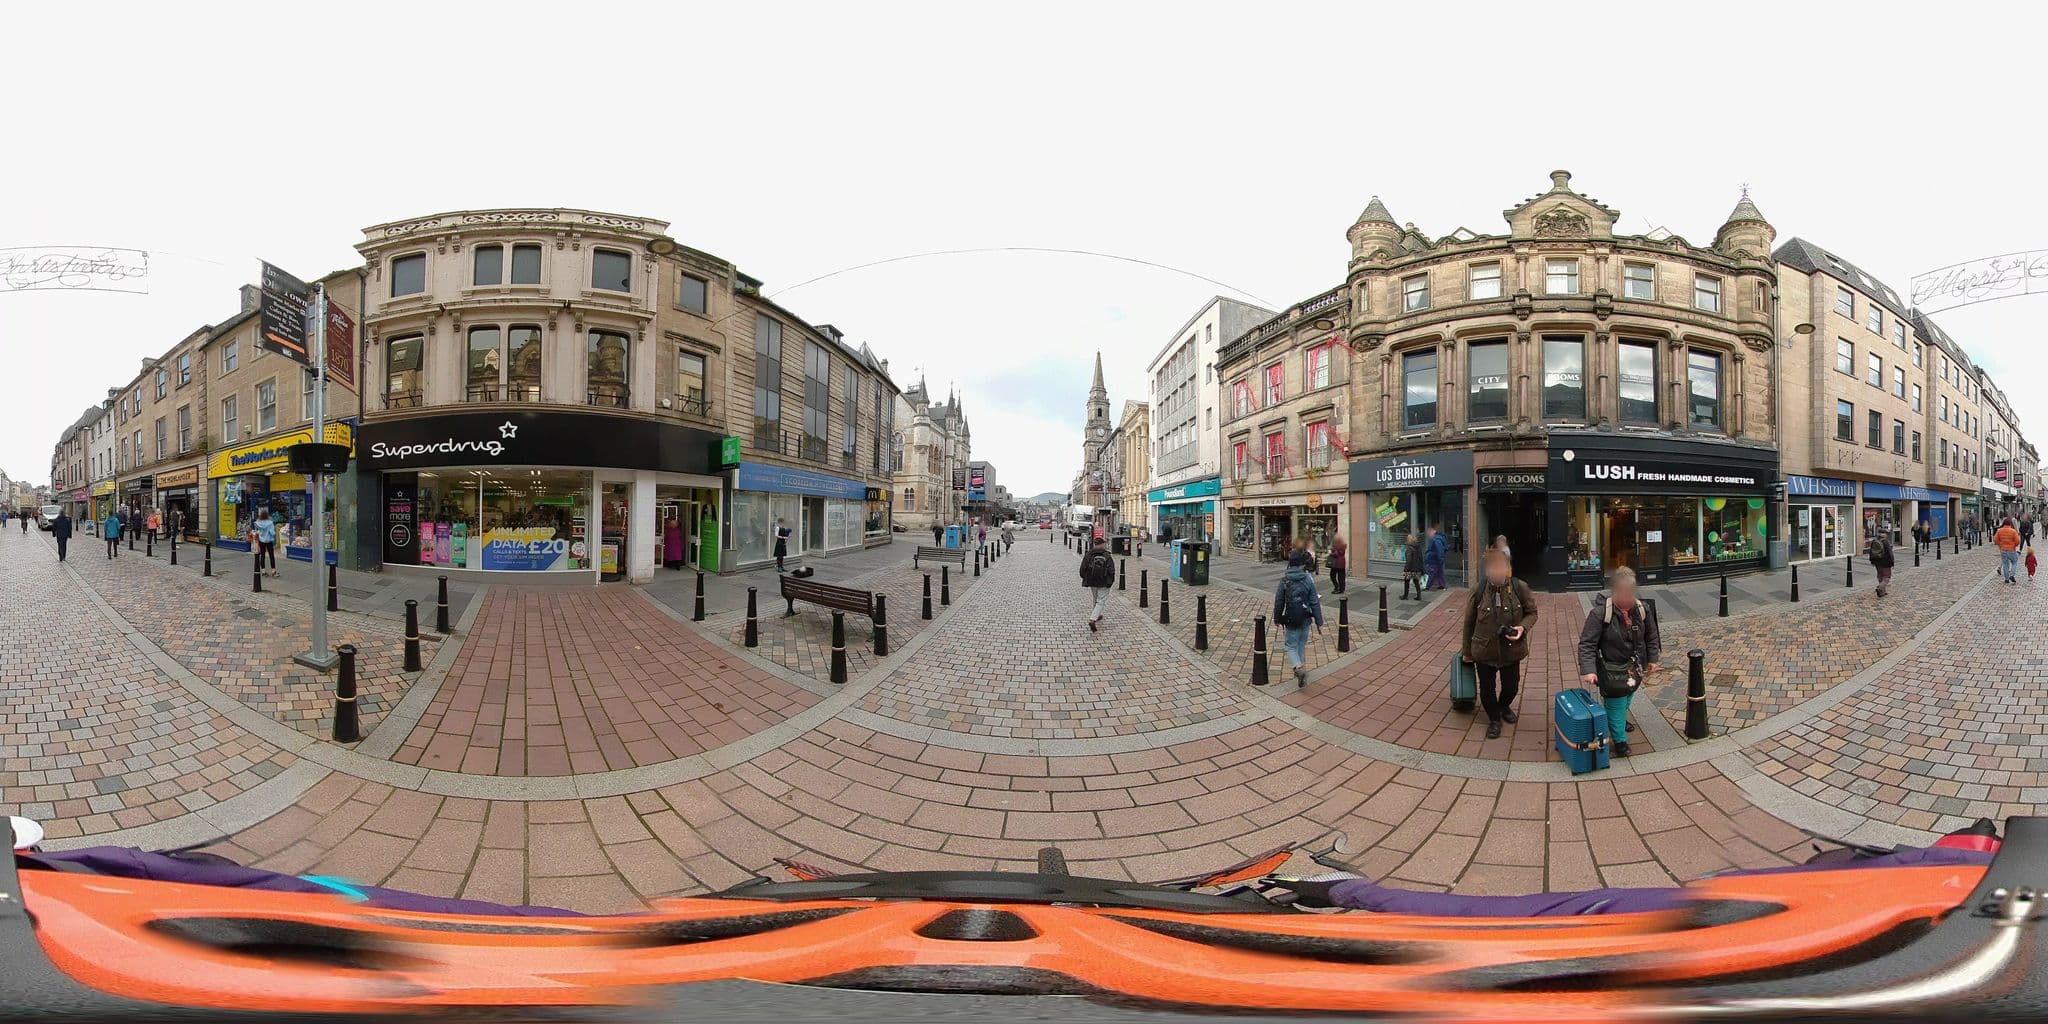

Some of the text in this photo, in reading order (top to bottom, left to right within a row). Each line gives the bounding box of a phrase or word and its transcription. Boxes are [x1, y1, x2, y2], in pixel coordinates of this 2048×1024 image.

[1477, 376, 1501, 384] CITY
[371, 438, 505, 459] Superdrug
[1377, 465, 1435, 482] LOS BURRITO
[1481, 474, 1545, 484] CITY ROOMS
[1584, 464, 1755, 485] LUSH FRESH HANDMADE COSMETICS
[1791, 476, 1855, 496] WHSmith
[1165, 487, 1185, 498] Poundland
[1899, 487, 1930, 500] WHSmith
[389, 505, 411, 513] save
[389, 513, 411, 521] more
[493, 526, 556, 537] UNLIMITED
[493, 538, 527, 549] DATA
[528, 538, 566, 554] £20
